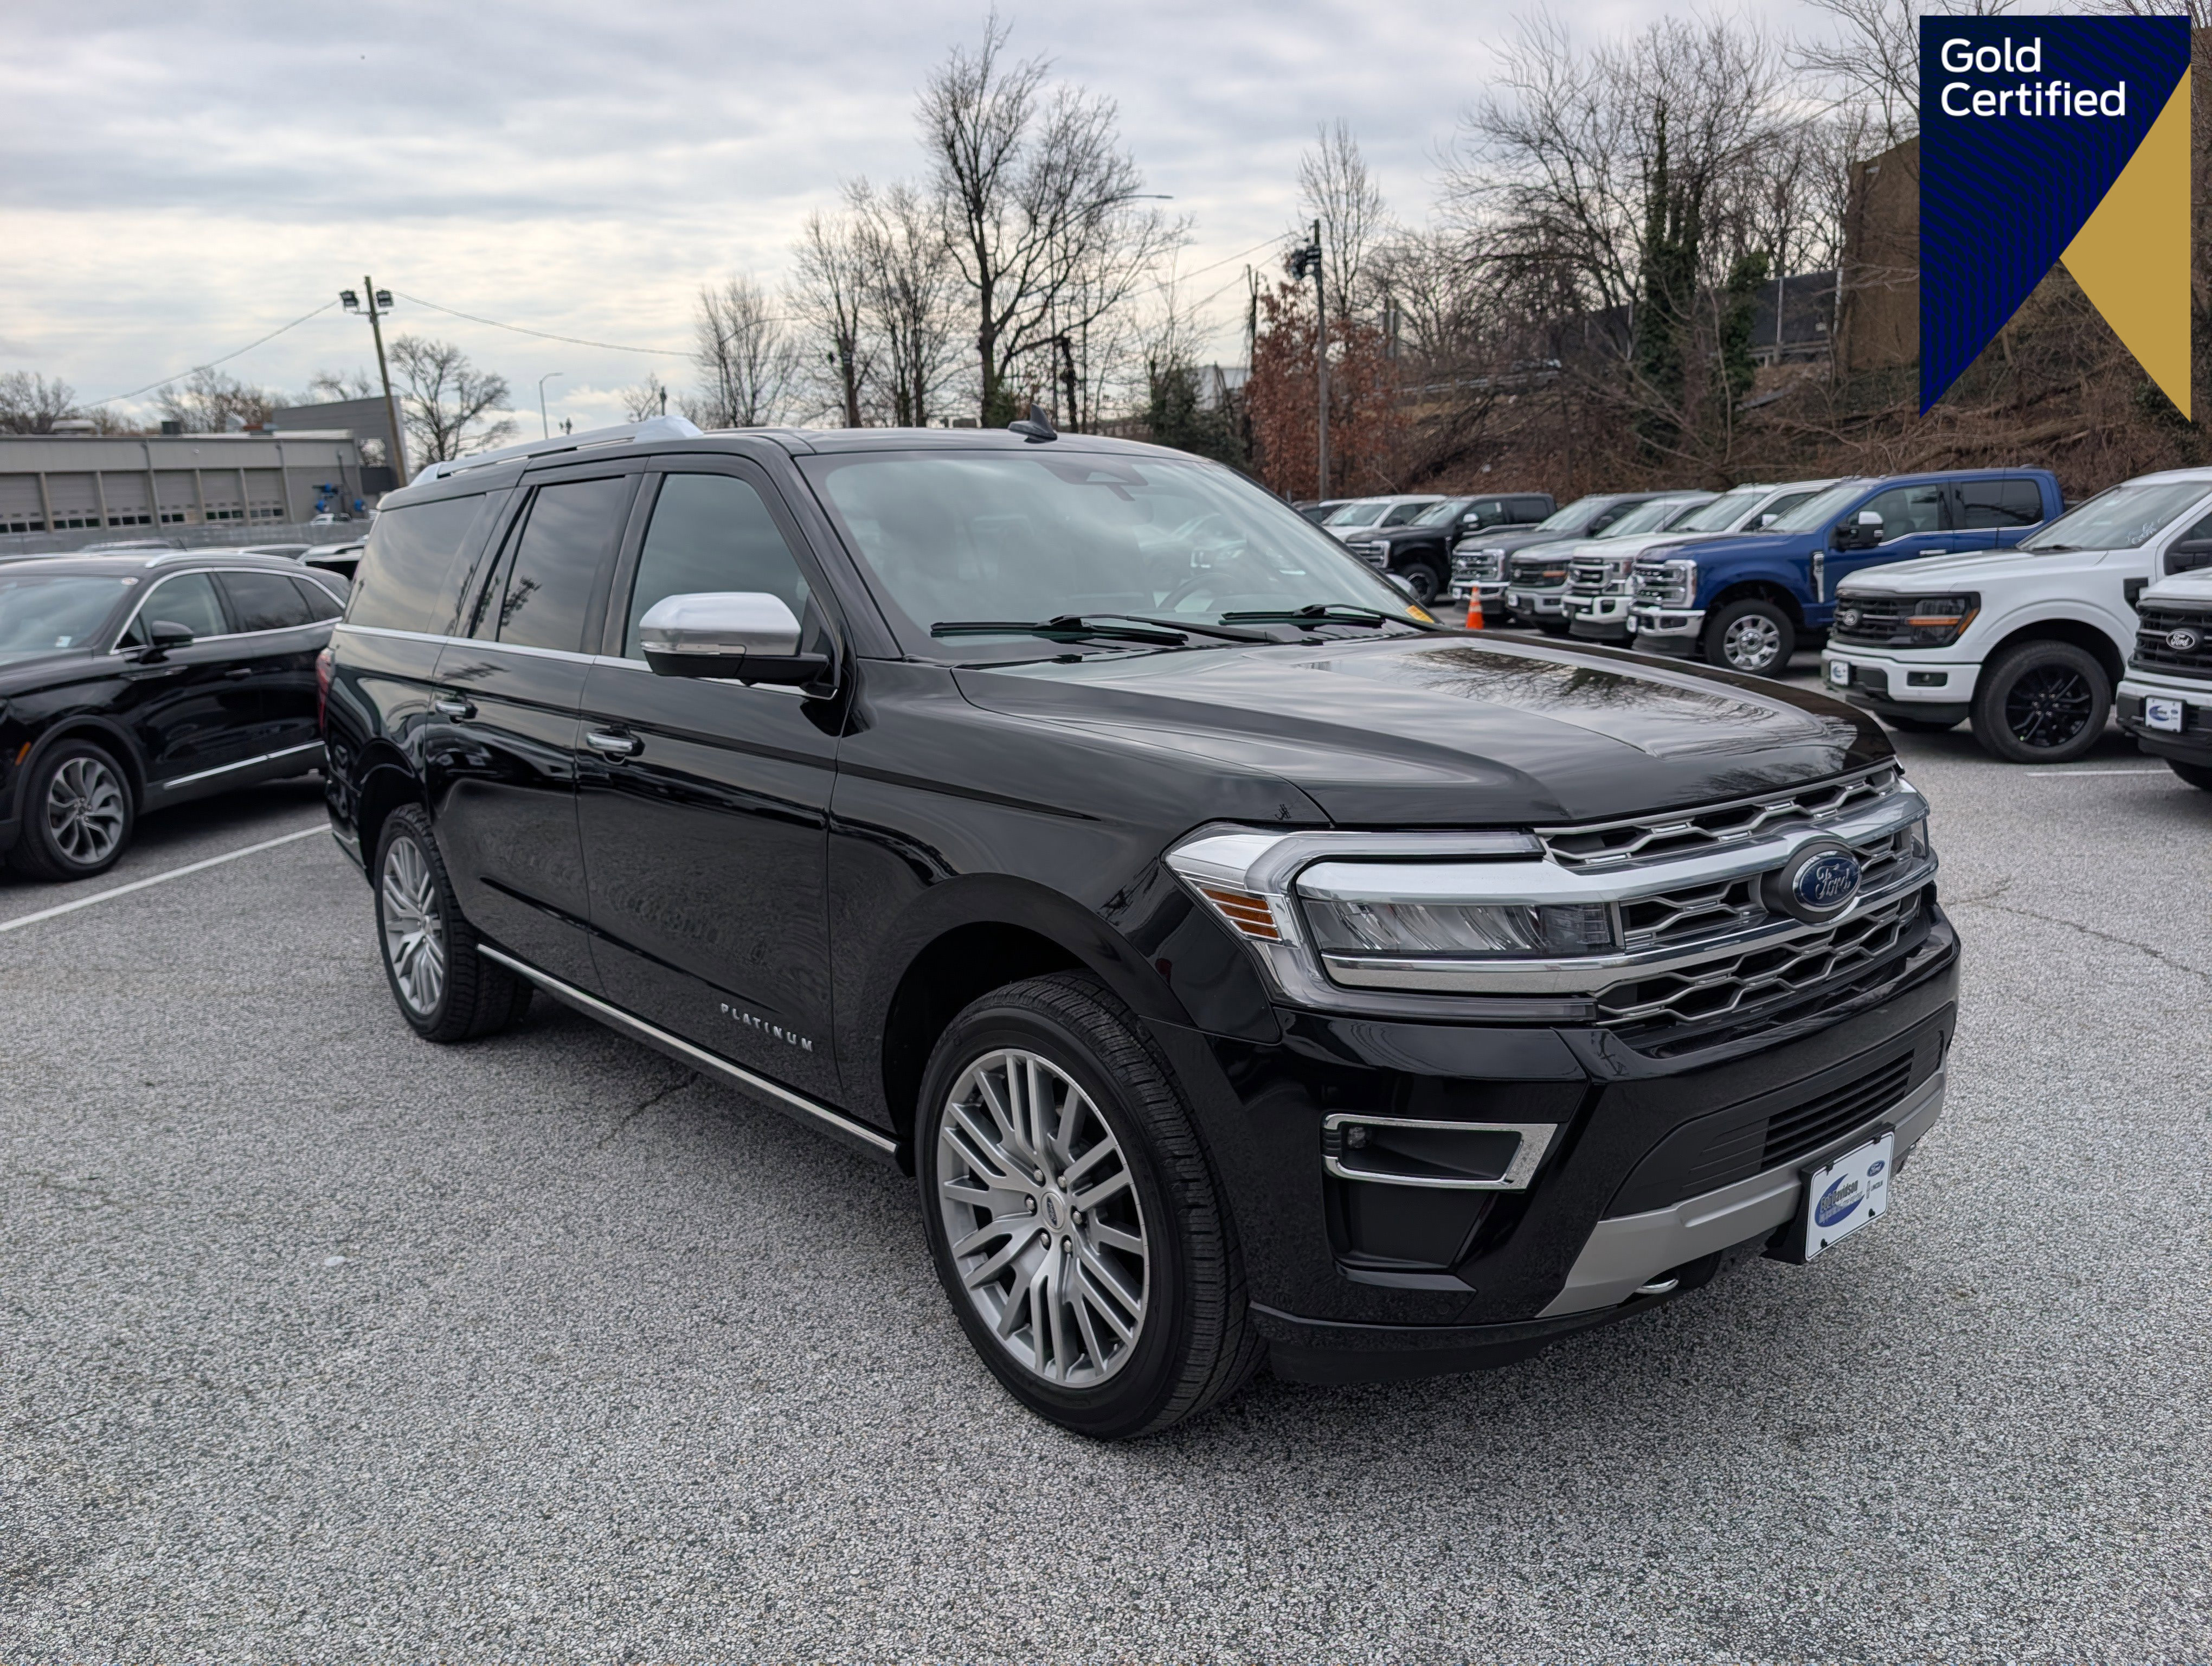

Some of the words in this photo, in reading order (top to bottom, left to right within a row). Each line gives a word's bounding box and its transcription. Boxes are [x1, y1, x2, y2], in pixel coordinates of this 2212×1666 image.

[2171, 633, 2190, 646] Ford
[1815, 863, 1851, 900] Ford
[721, 1003, 813, 1052] PLATINUM
[1832, 1180, 1859, 1206] Davidson
